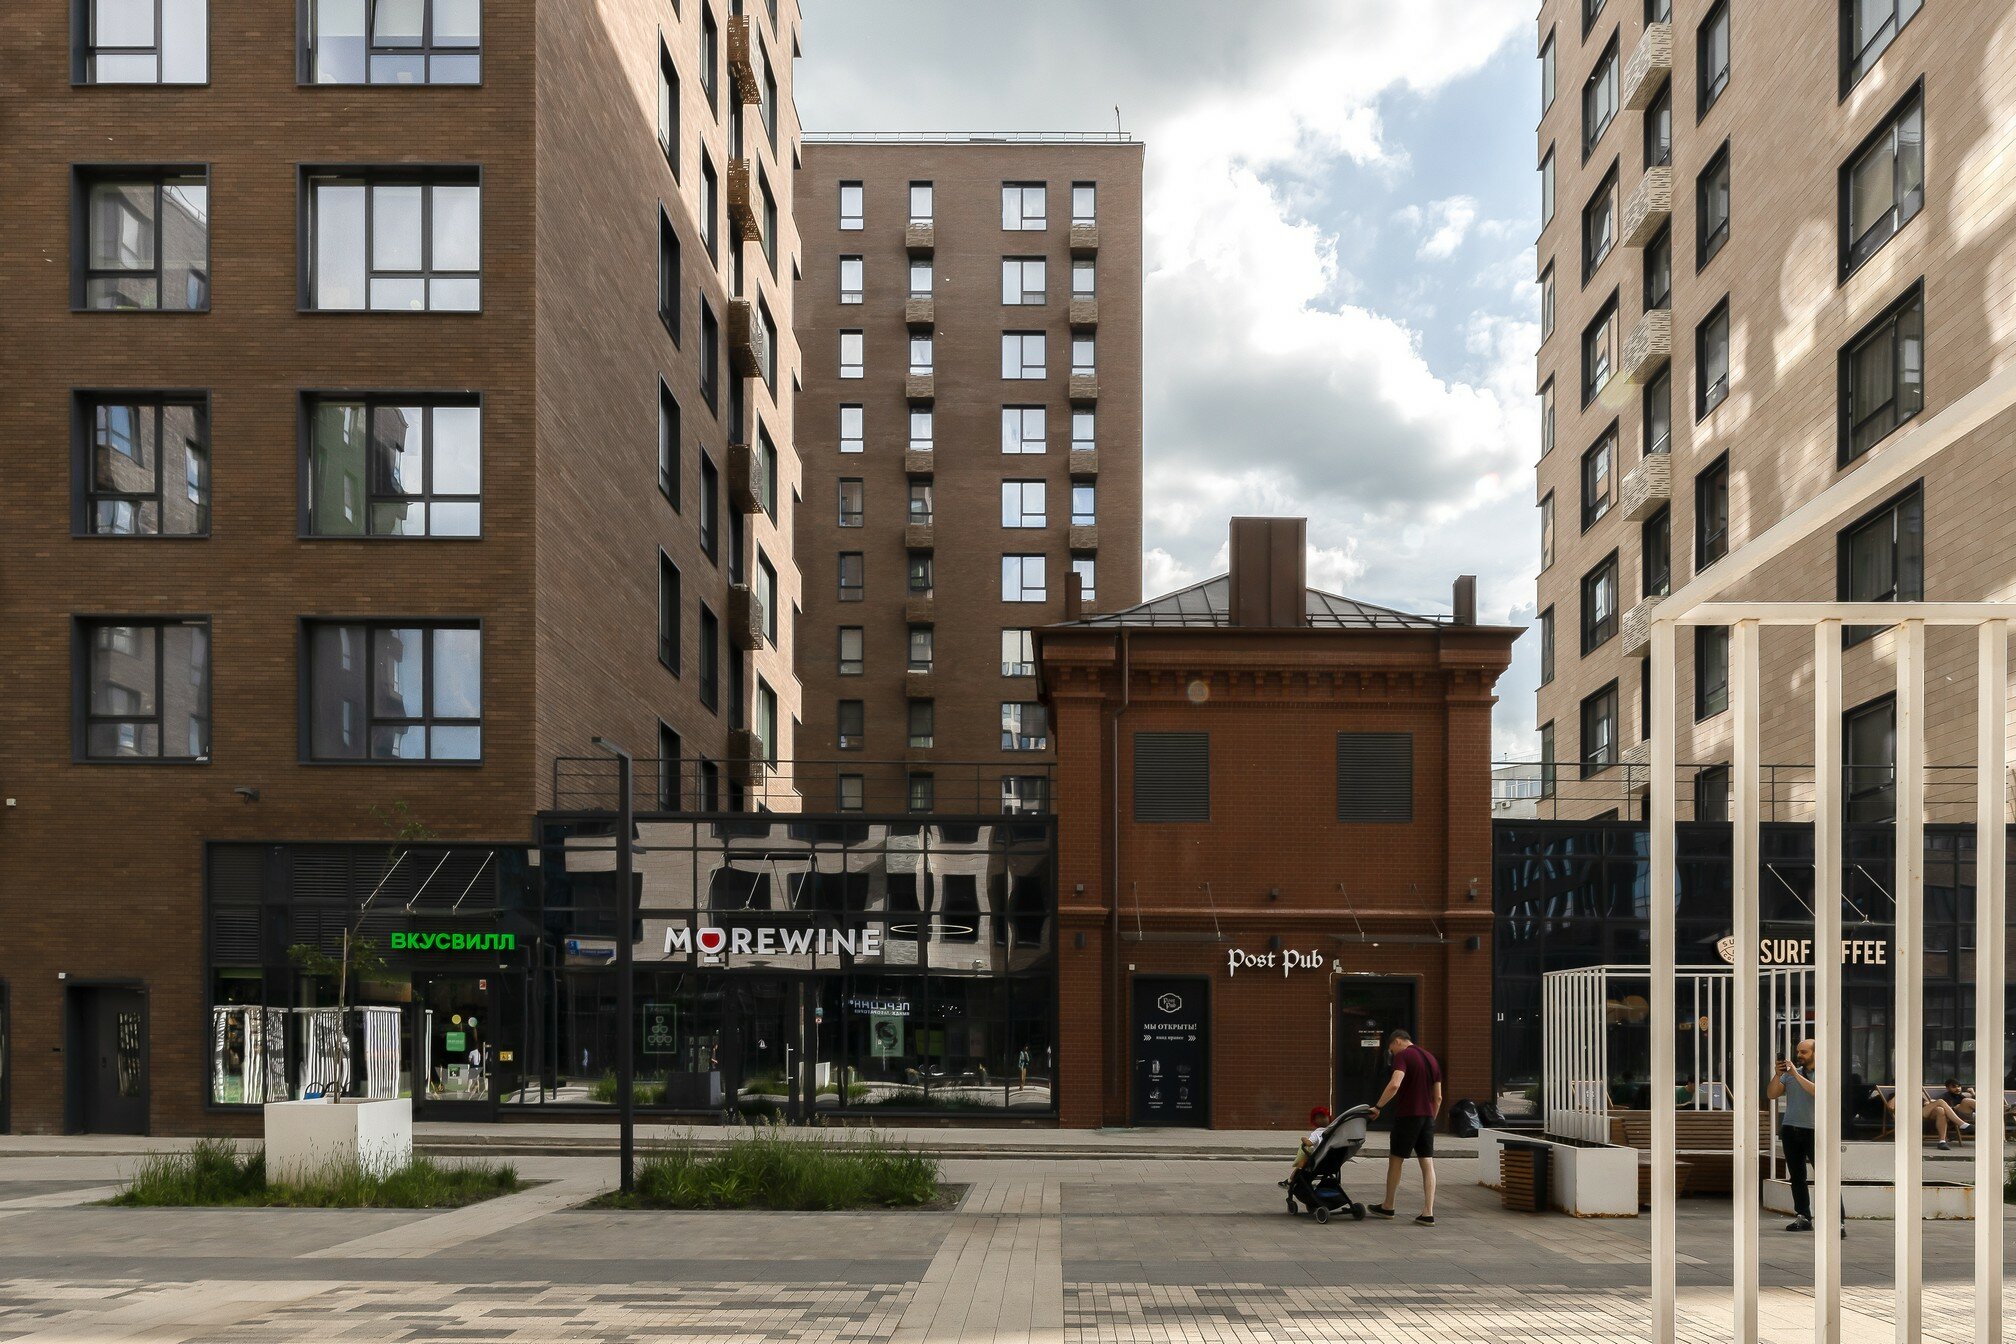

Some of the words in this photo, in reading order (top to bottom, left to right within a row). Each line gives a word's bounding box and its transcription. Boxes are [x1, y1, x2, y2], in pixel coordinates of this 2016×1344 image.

[391, 932, 515, 950] ВКУСВИЛЛ
[663, 926, 881, 964] MOREWINE
[1760, 939, 1812, 964] SURF
[1841, 940, 1887, 965] FFEE
[1227, 948, 1276, 978] Post
[1282, 948, 1324, 979] Pub
